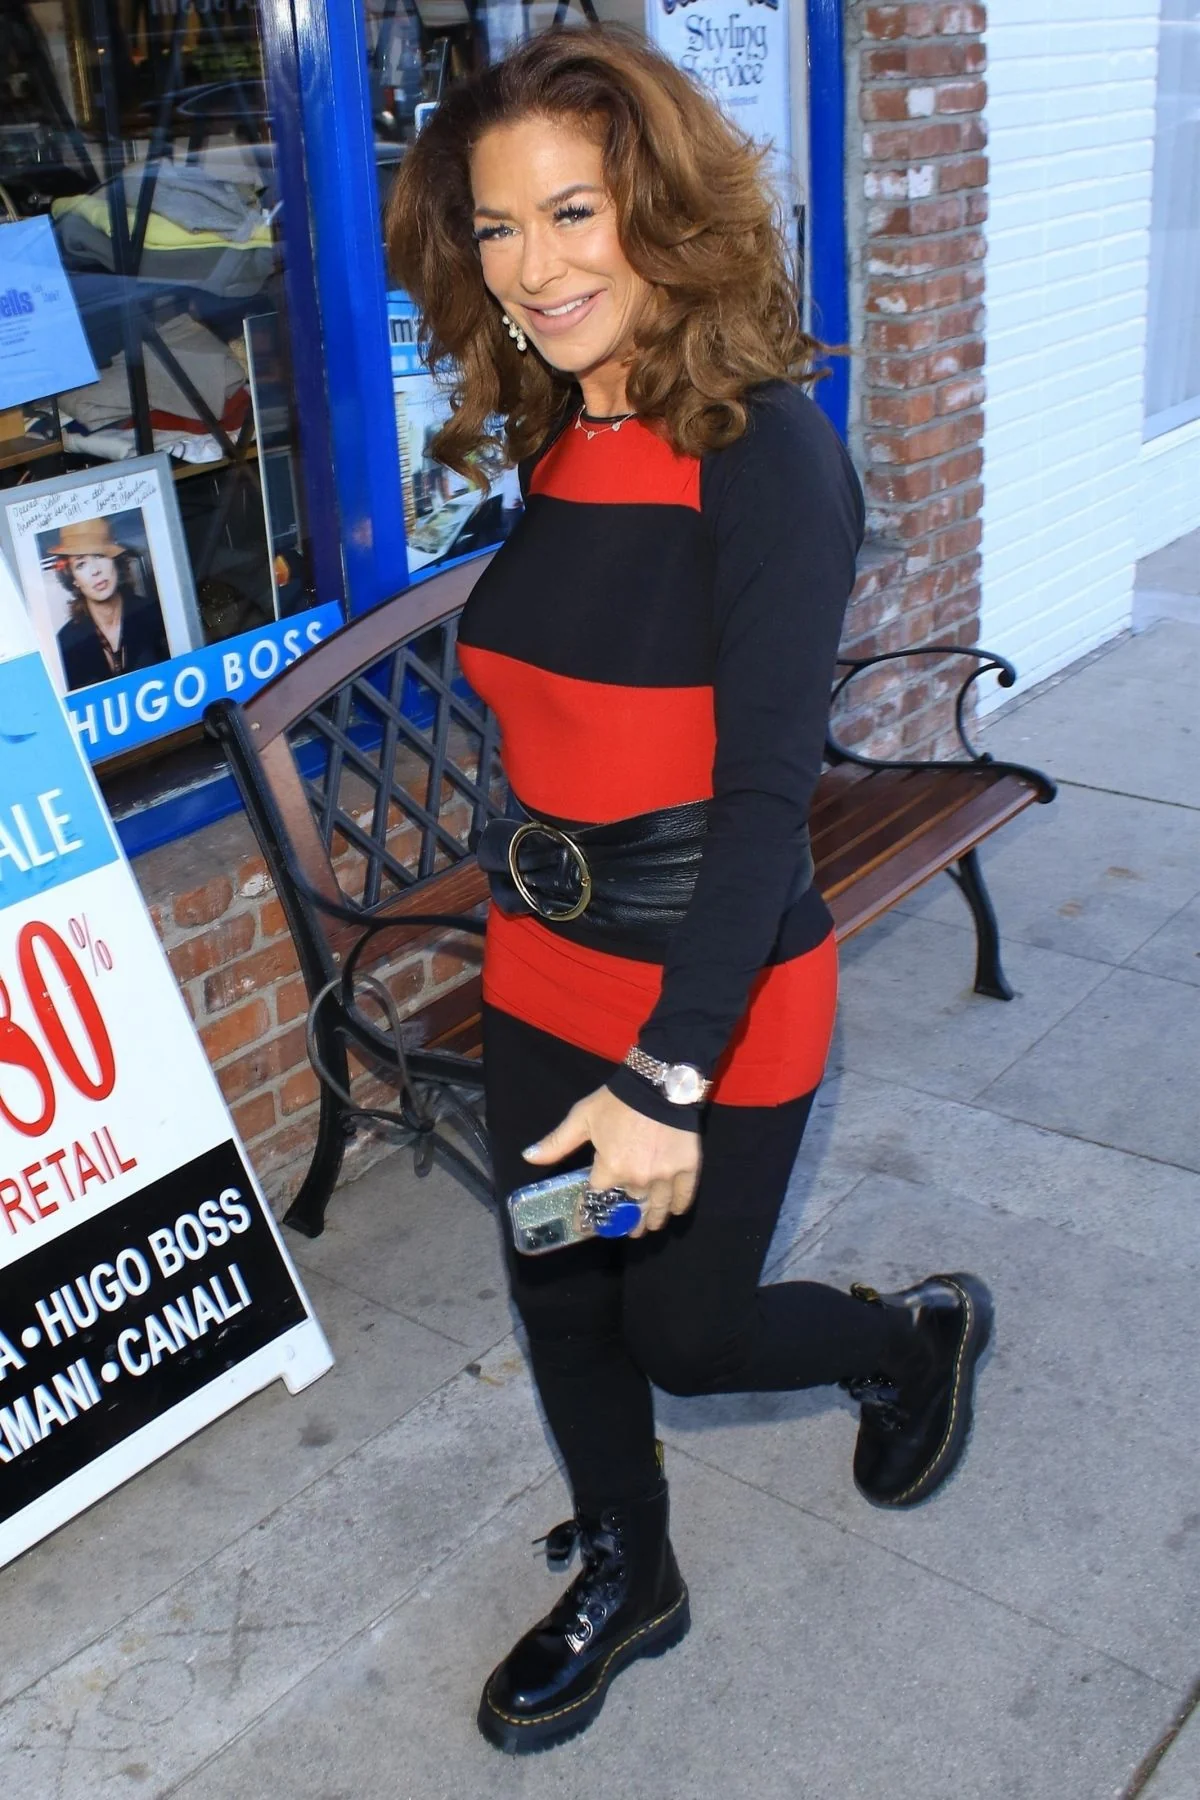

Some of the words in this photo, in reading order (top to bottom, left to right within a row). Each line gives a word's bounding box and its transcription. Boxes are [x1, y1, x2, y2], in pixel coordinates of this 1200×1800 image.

[684, 13, 769, 63] Styling
[69, 666, 207, 745] HUGO
[222, 621, 324, 692] BOSS
[0, 1126, 138, 1235] RETAIL
[35, 1247, 152, 1347] HUGO
[147, 1187, 252, 1279] BOSS
[117, 1263, 253, 1377] CANALI
